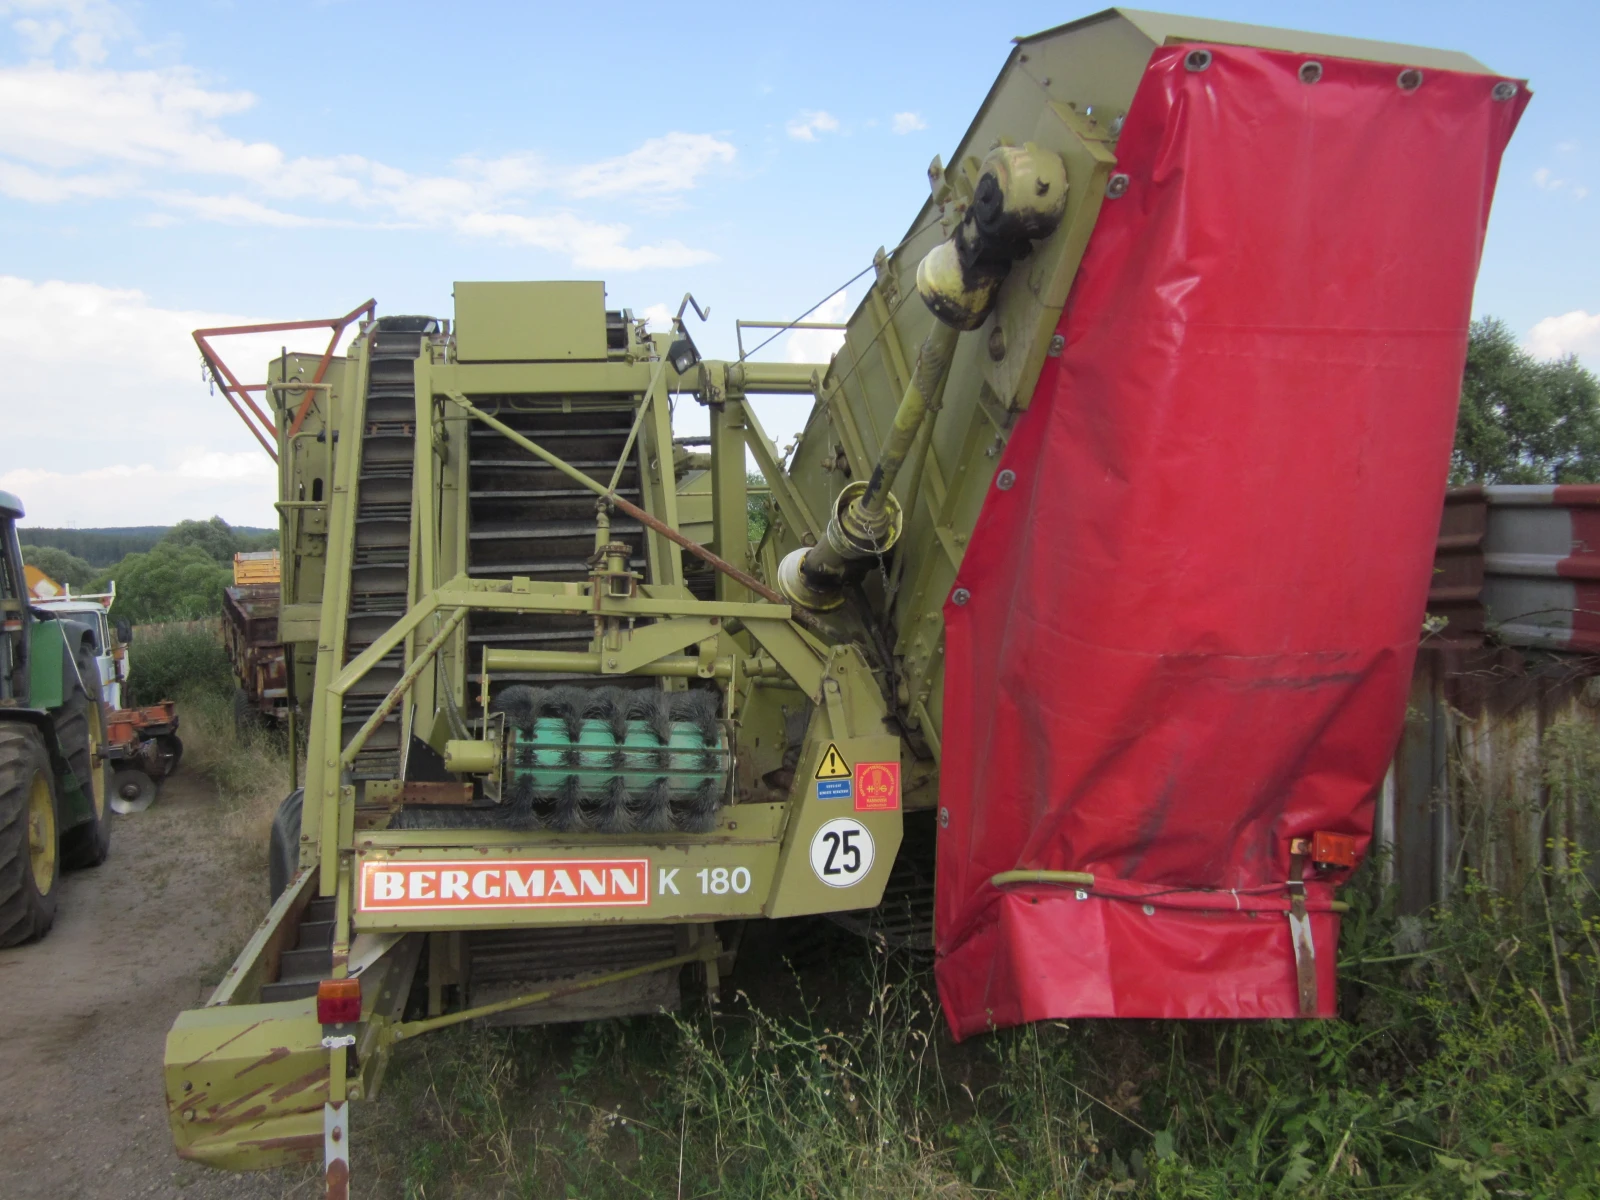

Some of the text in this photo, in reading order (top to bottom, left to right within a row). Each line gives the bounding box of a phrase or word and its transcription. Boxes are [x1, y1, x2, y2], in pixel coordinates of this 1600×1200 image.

[822, 830, 861, 875] 25
[373, 866, 752, 900] BERGMANN K 180
